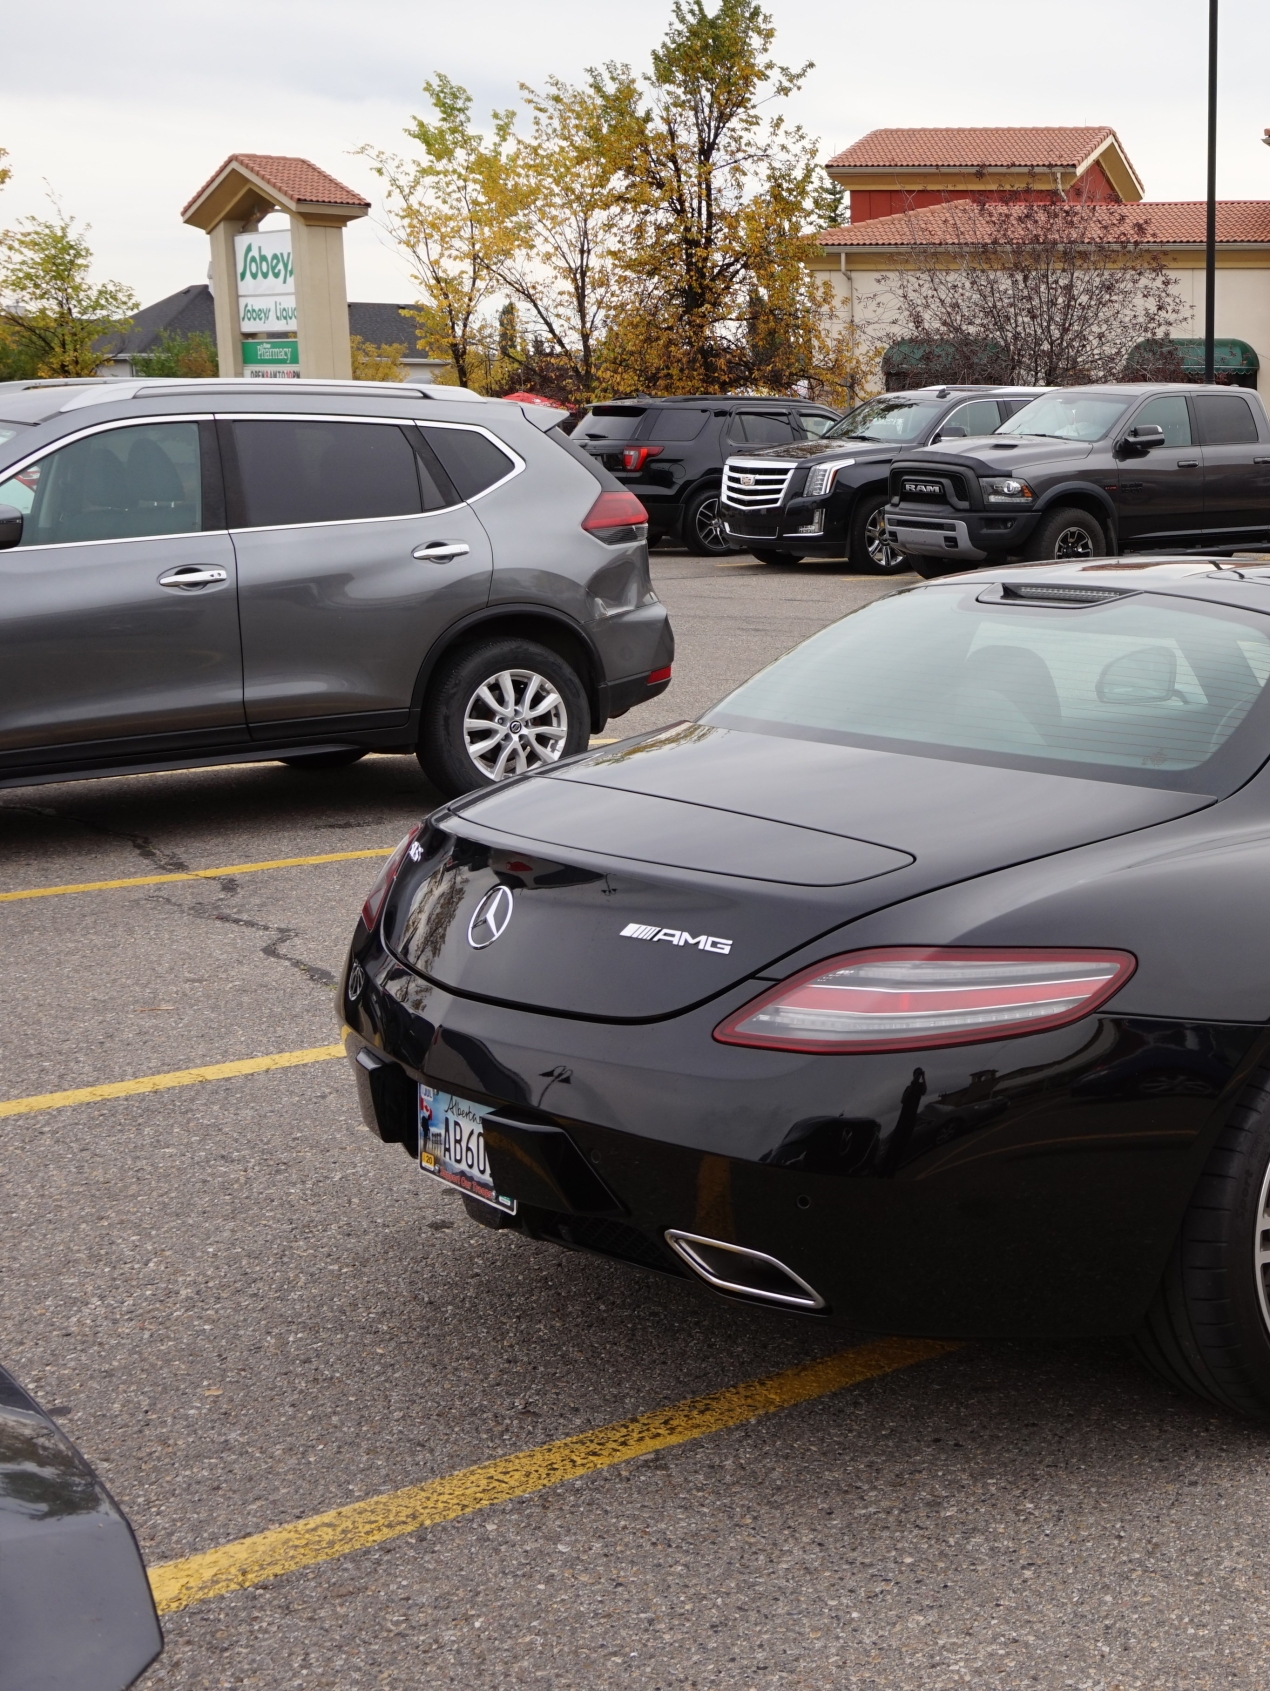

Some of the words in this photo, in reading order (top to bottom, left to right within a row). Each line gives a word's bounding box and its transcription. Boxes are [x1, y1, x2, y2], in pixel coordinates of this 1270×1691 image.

[242, 302, 271, 325] Sobeys
[257, 345, 291, 363] Pharmacy
[905, 484, 940, 493] RAM
[652, 928, 733, 955] AMG
[444, 1116, 488, 1175] AB60
[460, 1176, 471, 1190] Our
